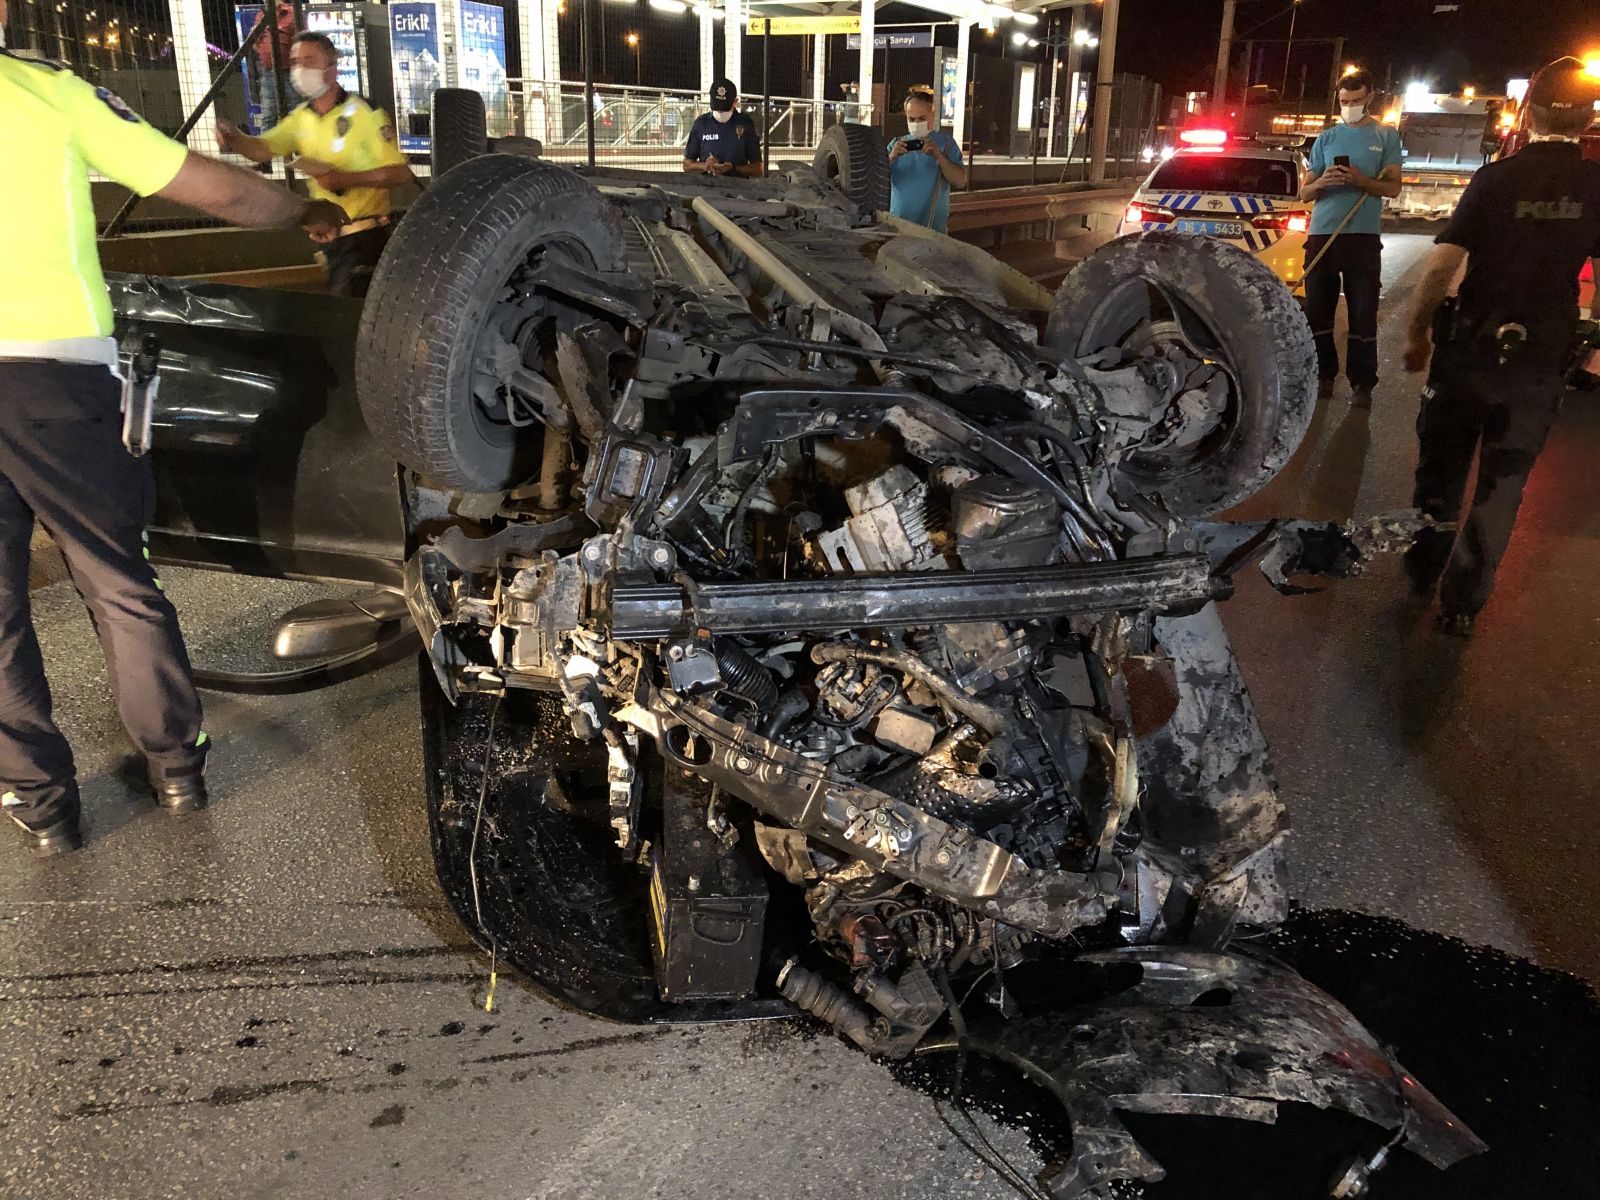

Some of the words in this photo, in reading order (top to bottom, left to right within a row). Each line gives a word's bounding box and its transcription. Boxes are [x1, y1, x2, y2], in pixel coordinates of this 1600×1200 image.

[395, 13, 430, 31] Erikli
[463, 11, 498, 36] Erikli
[874, 36, 888, 47] çük
[890, 35, 915, 45] Sanayi
[1199, 222, 1207, 233] A
[1214, 223, 1242, 235] 5433
